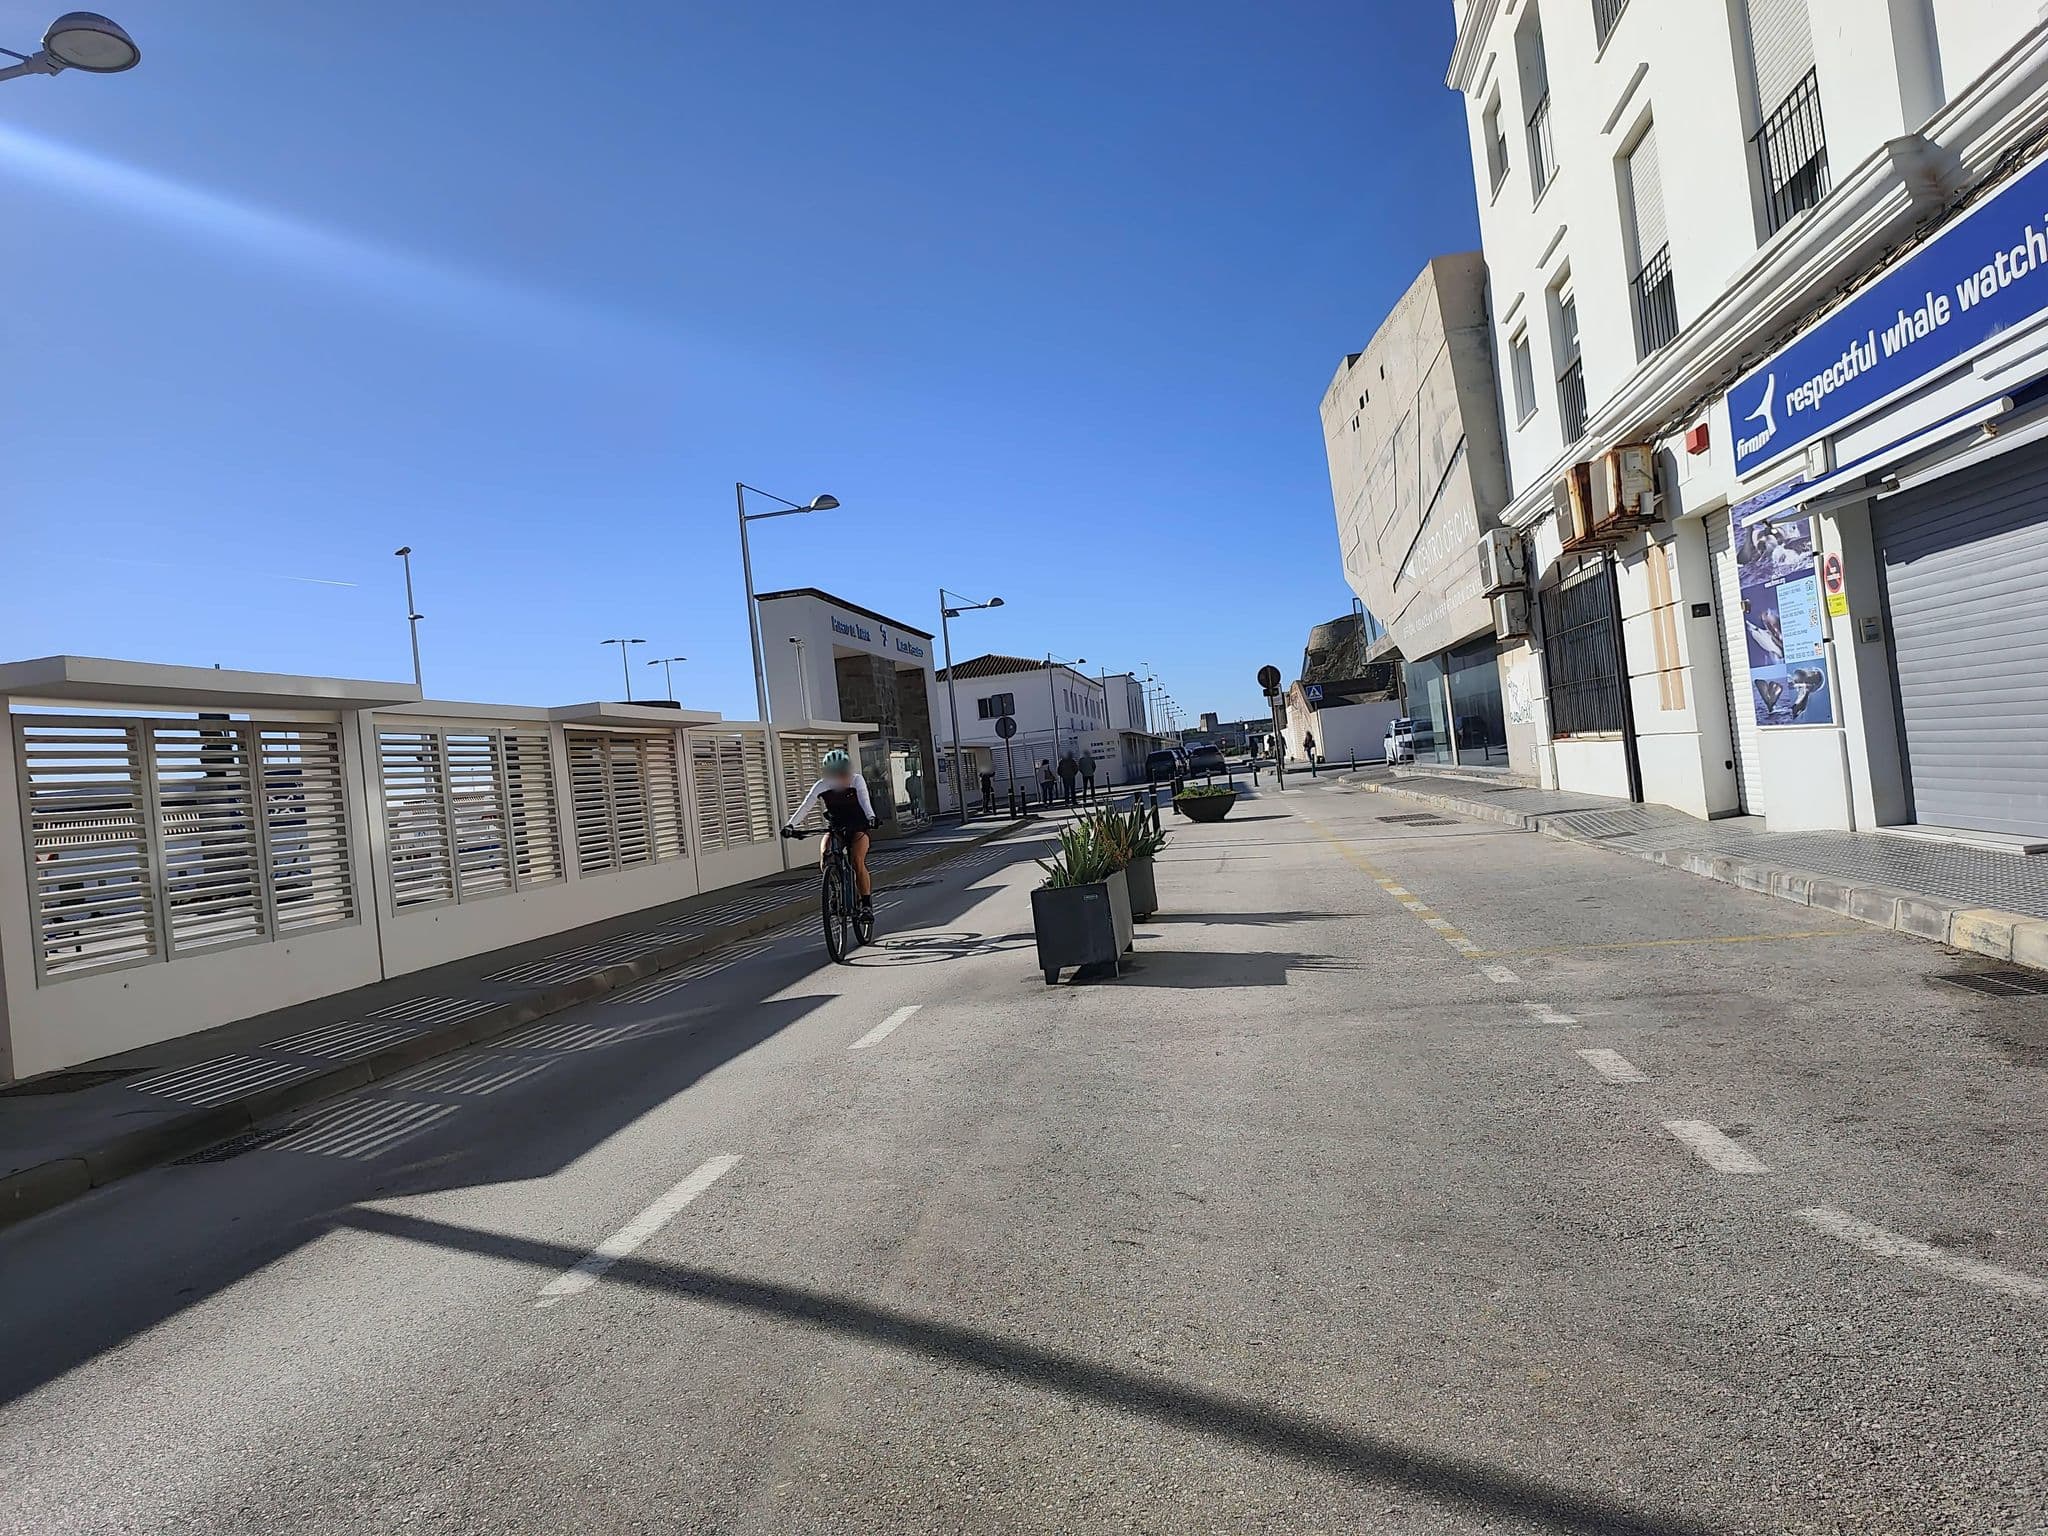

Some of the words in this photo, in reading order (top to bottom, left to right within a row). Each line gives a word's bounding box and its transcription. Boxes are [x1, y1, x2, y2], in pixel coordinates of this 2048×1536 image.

[1786, 331, 1877, 416] respectful
[1881, 292, 1950, 358] whale
[1956, 213, 2048, 312] watch
[1736, 429, 1770, 462] firmm
